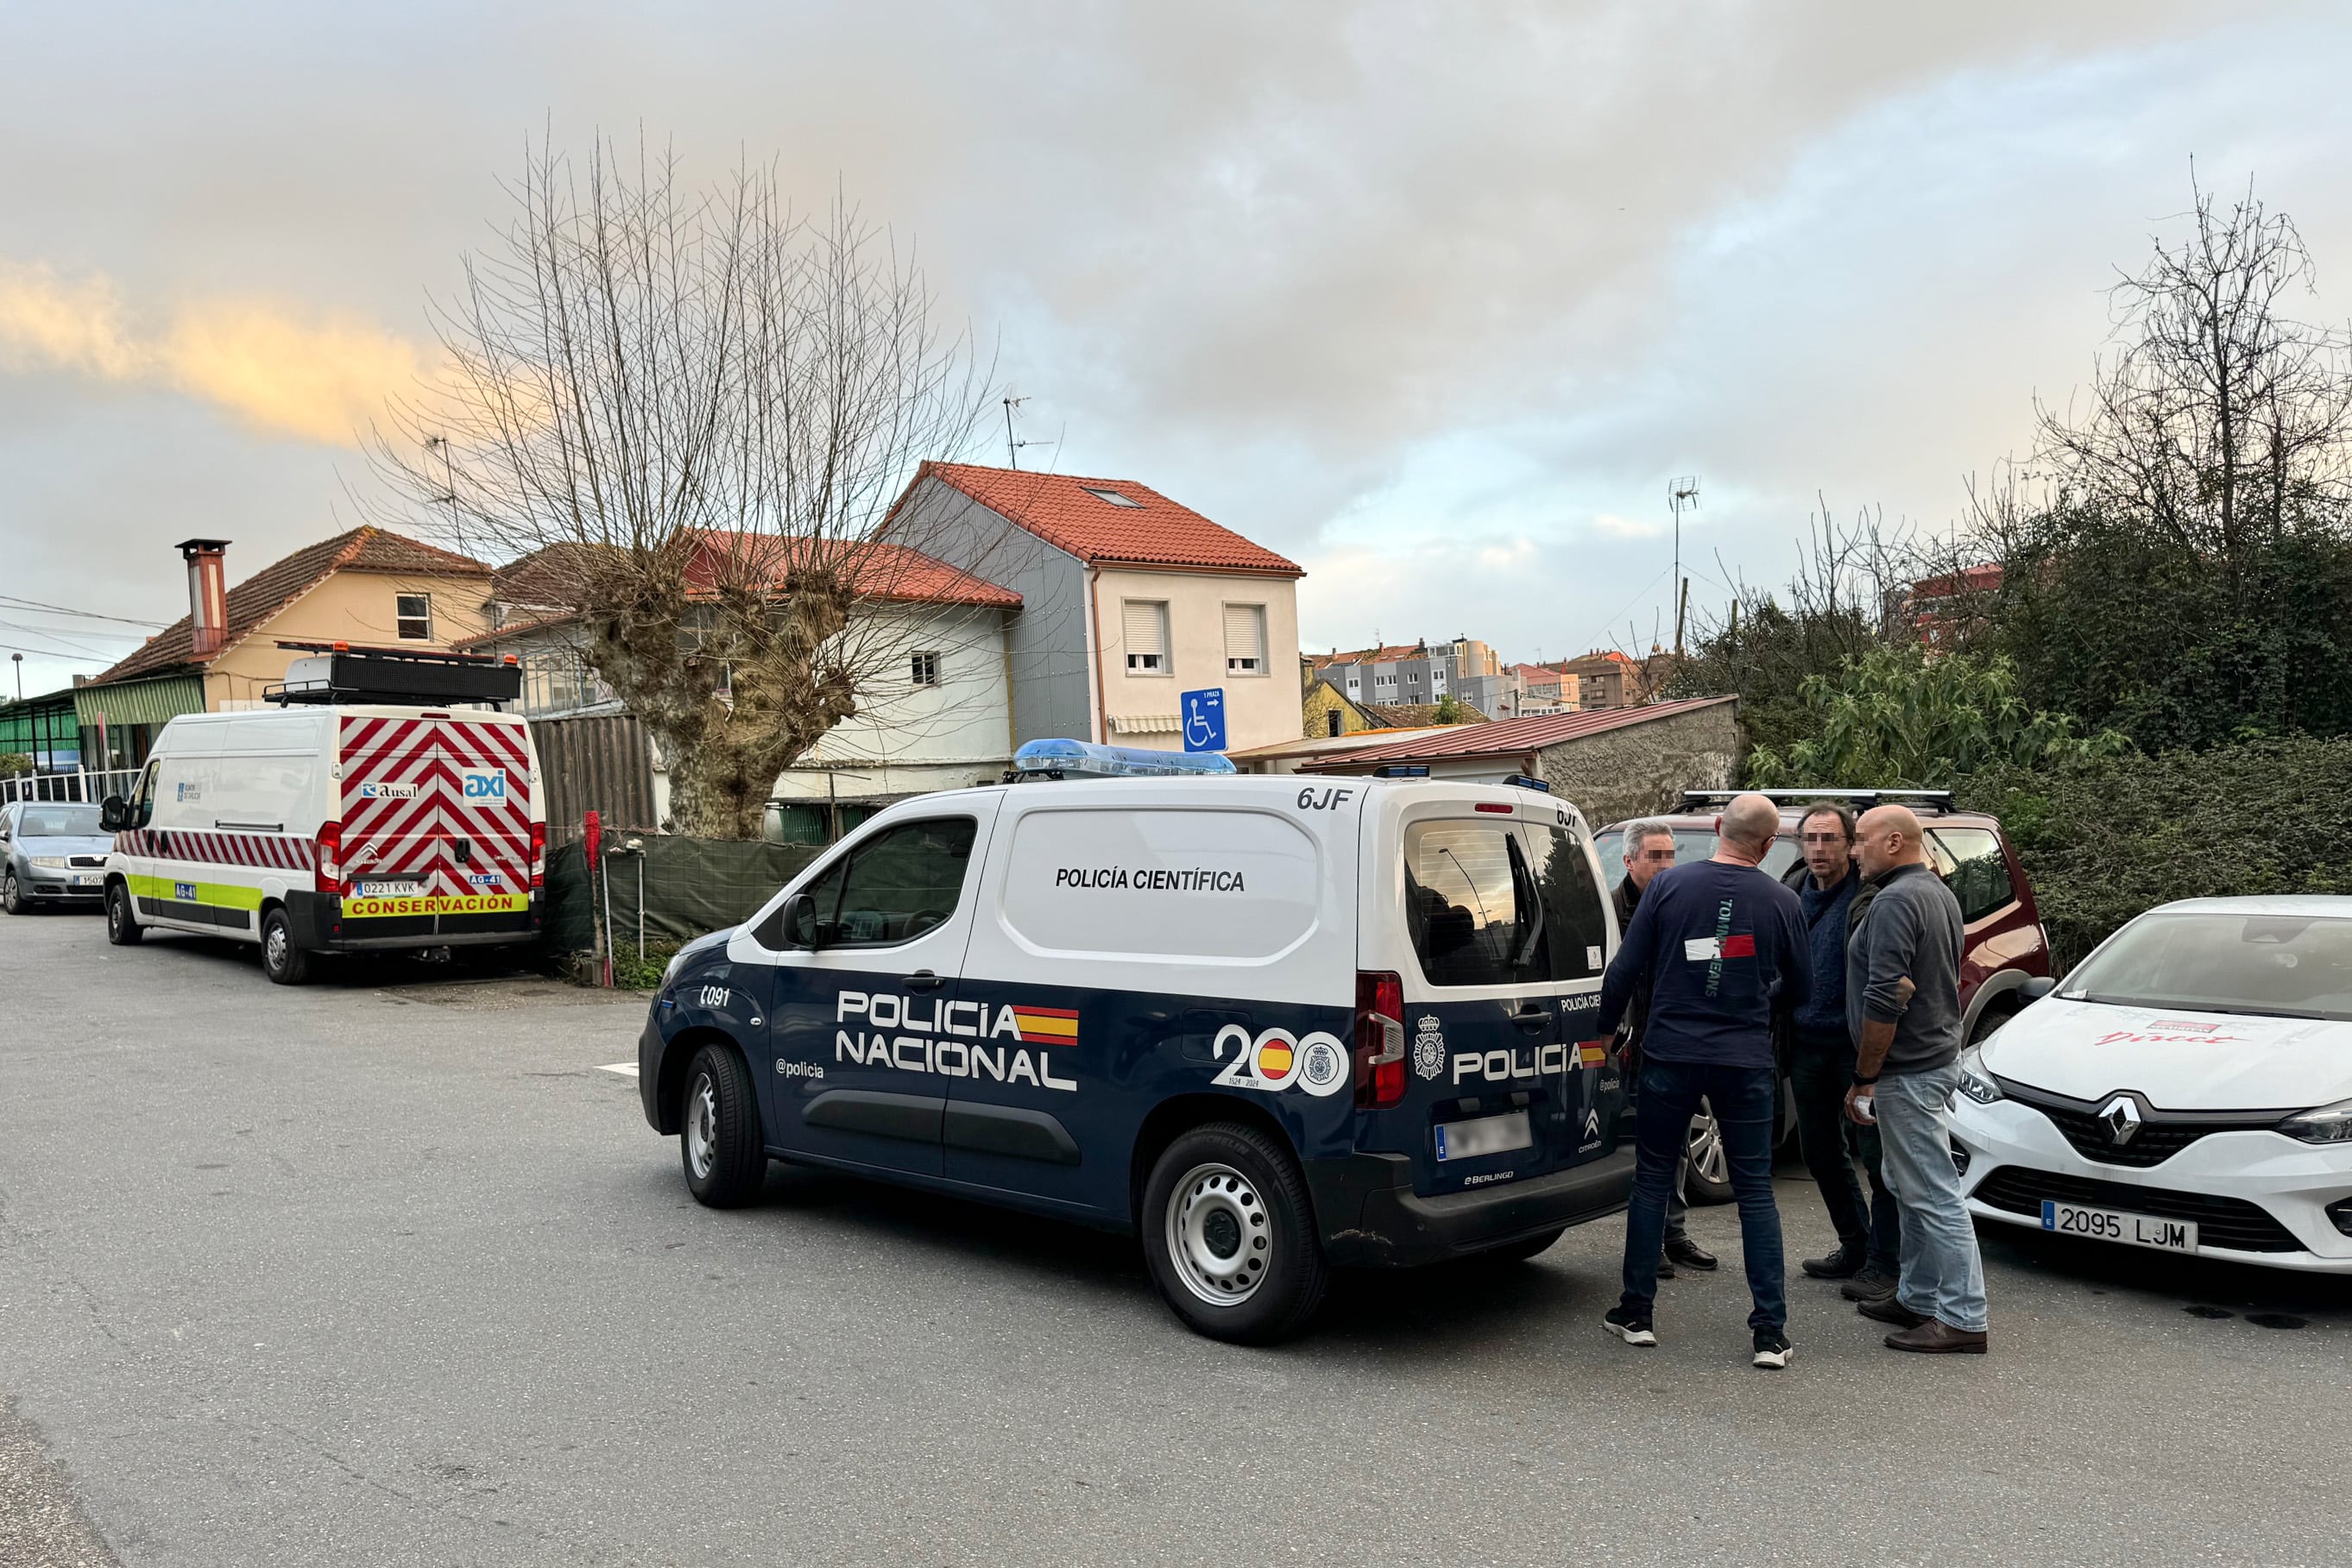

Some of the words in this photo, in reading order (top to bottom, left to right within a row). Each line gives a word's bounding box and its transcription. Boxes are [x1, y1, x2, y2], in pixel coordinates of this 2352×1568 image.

[1297, 786, 1353, 811] 6JF
[175, 883, 196, 898] AG-41
[364, 883, 391, 893] 0221
[394, 882, 414, 893] KVK
[470, 875, 500, 885] AG-41
[1056, 866, 1129, 890] POLICÍA
[1133, 867, 1245, 891] CIENTÍFICA
[352, 894, 513, 915] CONSERVACIÓN
[1713, 898, 1733, 952] TOMMY
[1705, 953, 1723, 998] JEANS
[1561, 993, 1590, 1012] POLICÍA
[836, 990, 1023, 1041] POLICÍA
[775, 1058, 824, 1079] @policia
[835, 1030, 1077, 1092] NACIONAL
[1210, 1023, 1350, 1097] 200
[1453, 1042, 1584, 1085] POLICÍA
[1439, 1146, 1445, 1155] E
[2060, 1207, 2121, 1238] 2095
[2136, 1219, 2185, 1249] LJM
